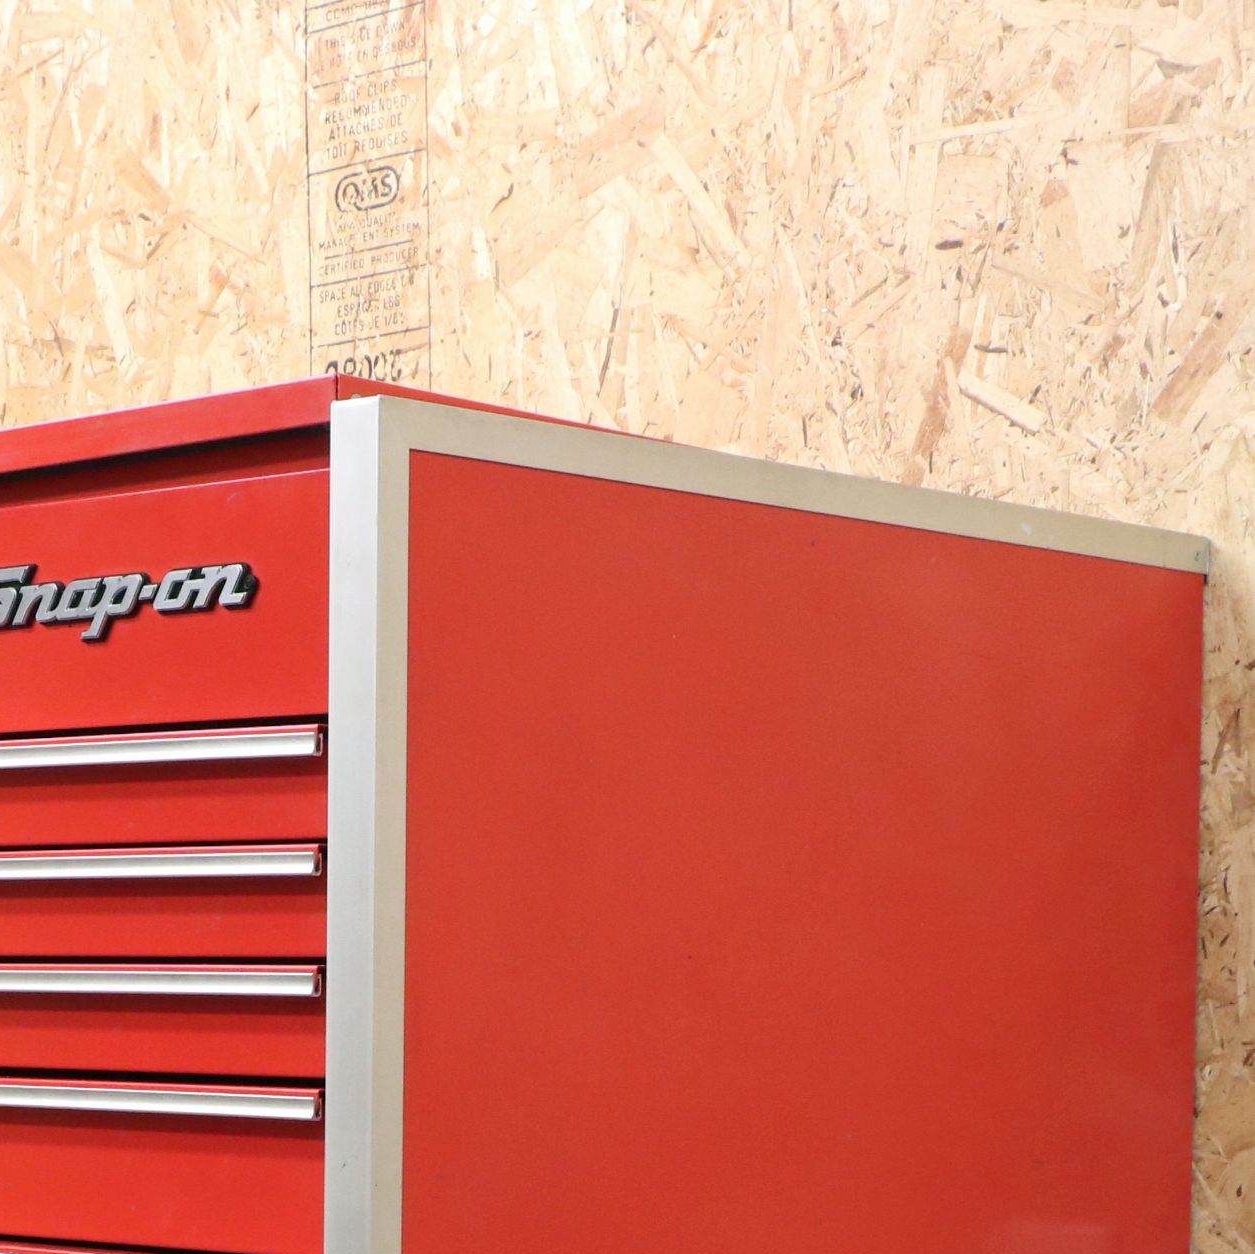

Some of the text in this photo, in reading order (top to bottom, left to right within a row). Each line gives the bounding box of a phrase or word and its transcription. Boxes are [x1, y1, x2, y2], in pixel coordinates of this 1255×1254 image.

[326, 35, 345, 50] THIS
[367, 79, 397, 97] CLIPS
[325, 94, 407, 124] RECOMMENDED
[329, 112, 403, 141] ATTACHES DE
[319, 247, 419, 276] CERTIFIED PRODUCER
